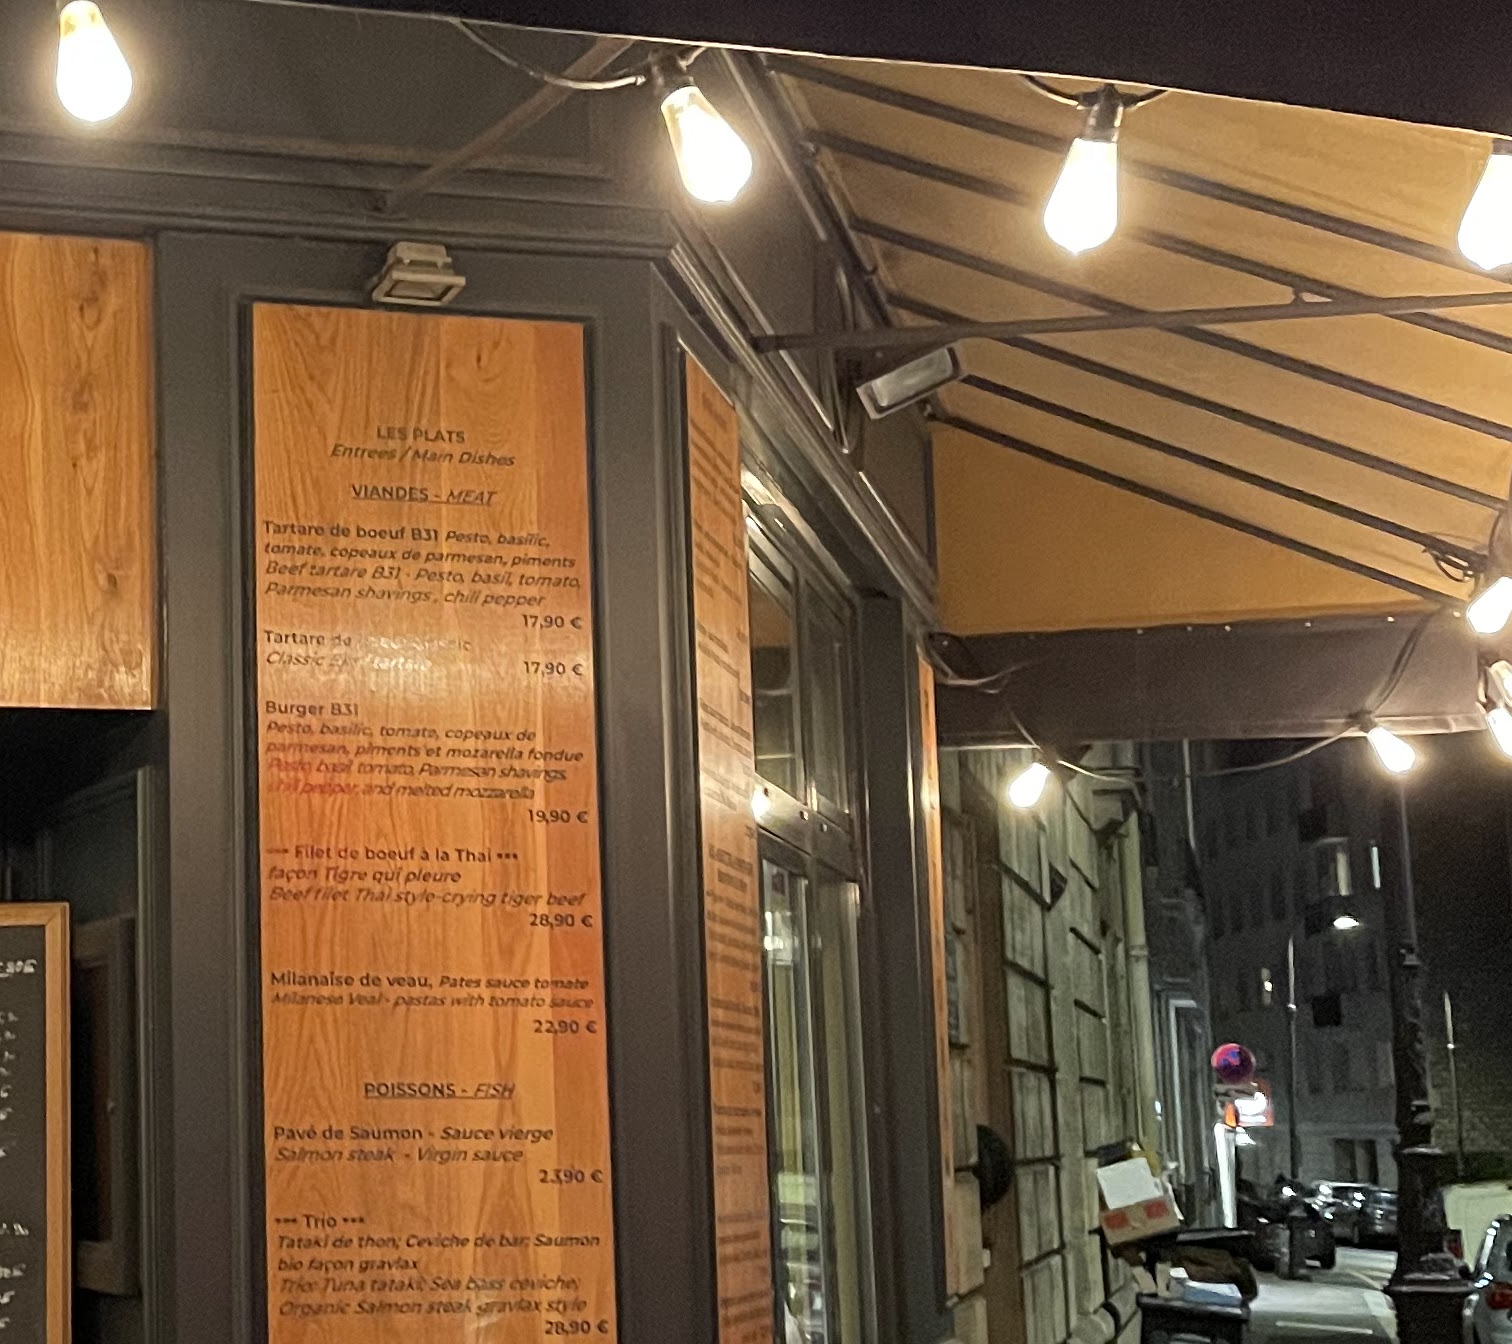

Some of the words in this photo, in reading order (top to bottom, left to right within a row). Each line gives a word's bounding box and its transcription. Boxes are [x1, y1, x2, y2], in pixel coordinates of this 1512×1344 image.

[376, 425, 408, 442] LES
[413, 428, 466, 445] PLATS
[352, 484, 428, 502] VIANDES
[446, 489, 497, 505] MEAT
[264, 520, 324, 536] Tartare
[330, 523, 350, 537] de
[356, 525, 405, 539] boeuf
[411, 527, 438, 541] B31
[330, 546, 396, 560] copeaux
[402, 548, 420, 560] de
[511, 553, 576, 568] piments
[265, 582, 351, 598] Parmesan
[522, 614, 565, 630] 17,90
[264, 630, 325, 646] Tartare
[523, 660, 566, 676] 17,90
[265, 700, 324, 717] Burger
[331, 702, 359, 716] B31
[529, 809, 571, 825] 19,90
[339, 846, 359, 860] de
[365, 846, 414, 860] boeuf
[436, 848, 450, 862] la
[372, 868, 402, 883] qui
[405, 869, 461, 885] pleure
[530, 913, 575, 929] 28,90
[360, 973, 382, 987] de
[387, 975, 433, 990] veau,
[534, 1019, 579, 1035] 22,90
[364, 1083, 455, 1097] POISSONS
[322, 1126, 344, 1141] de
[349, 1126, 423, 1141] Saumon
[439, 1126, 494, 1141] Sauce
[499, 1126, 554, 1143] vierge
[303, 1214, 337, 1229] Trio
[545, 1320, 590, 1336] 28,90
